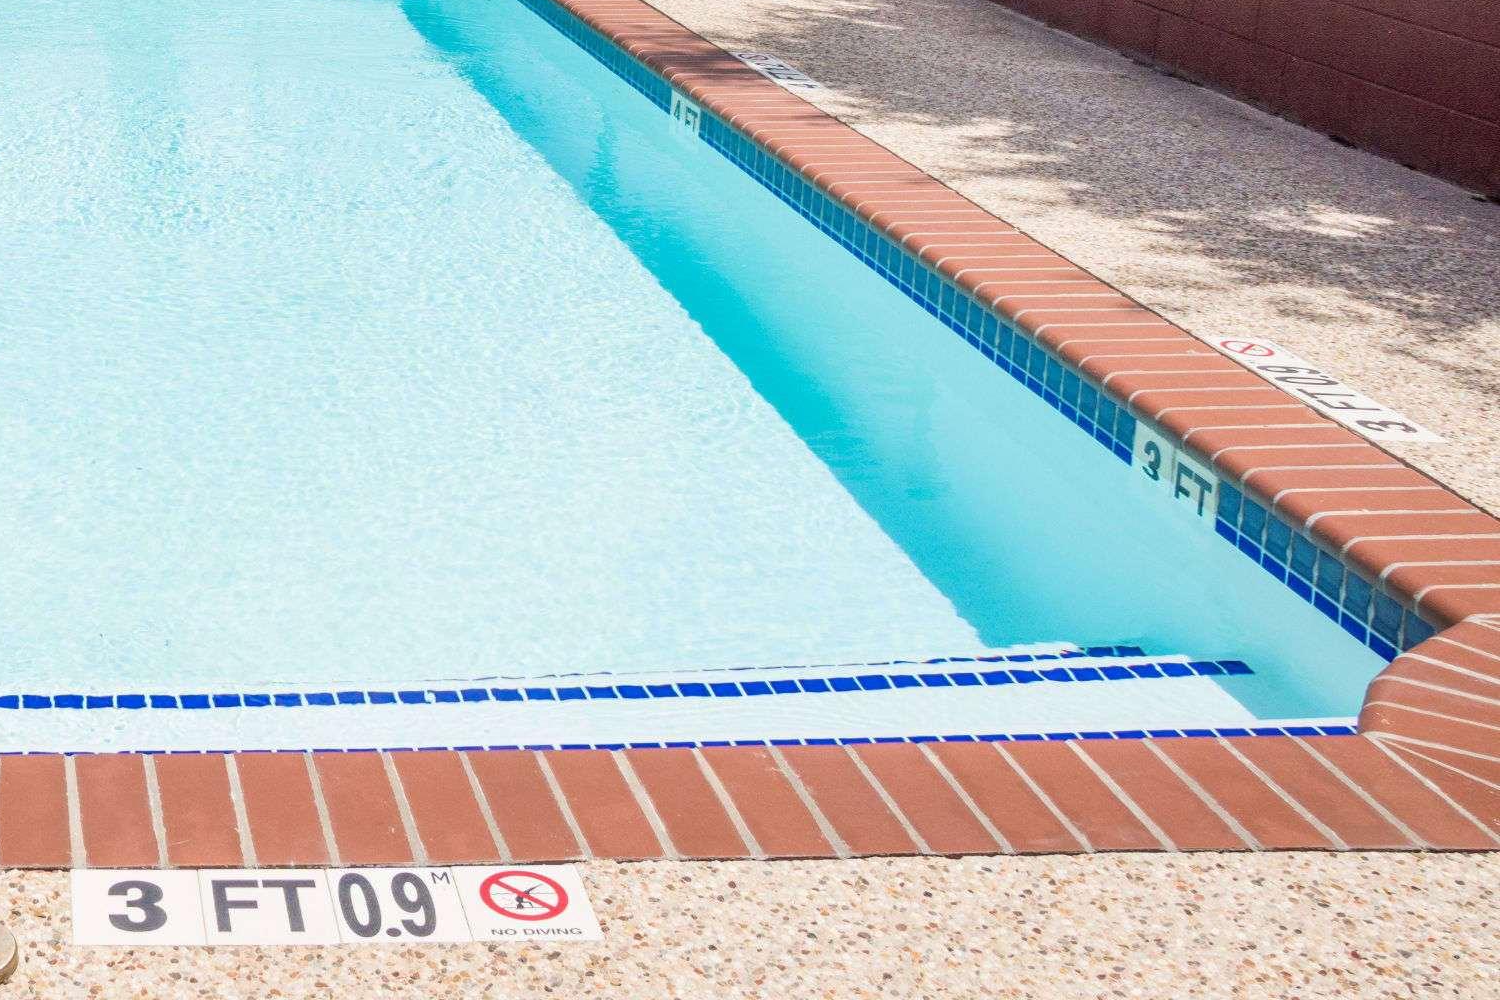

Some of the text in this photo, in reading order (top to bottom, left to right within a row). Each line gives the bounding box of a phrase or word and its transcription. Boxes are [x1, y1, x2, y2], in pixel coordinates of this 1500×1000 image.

[685, 106, 698, 132] FT
[1296, 388, 1382, 411] FT
[1355, 420, 1418, 433] 3
[1142, 440, 1213, 517] 3 FT
[108, 880, 168, 933] 3
[211, 879, 317, 933] FT
[338, 872, 438, 938] 0.9
